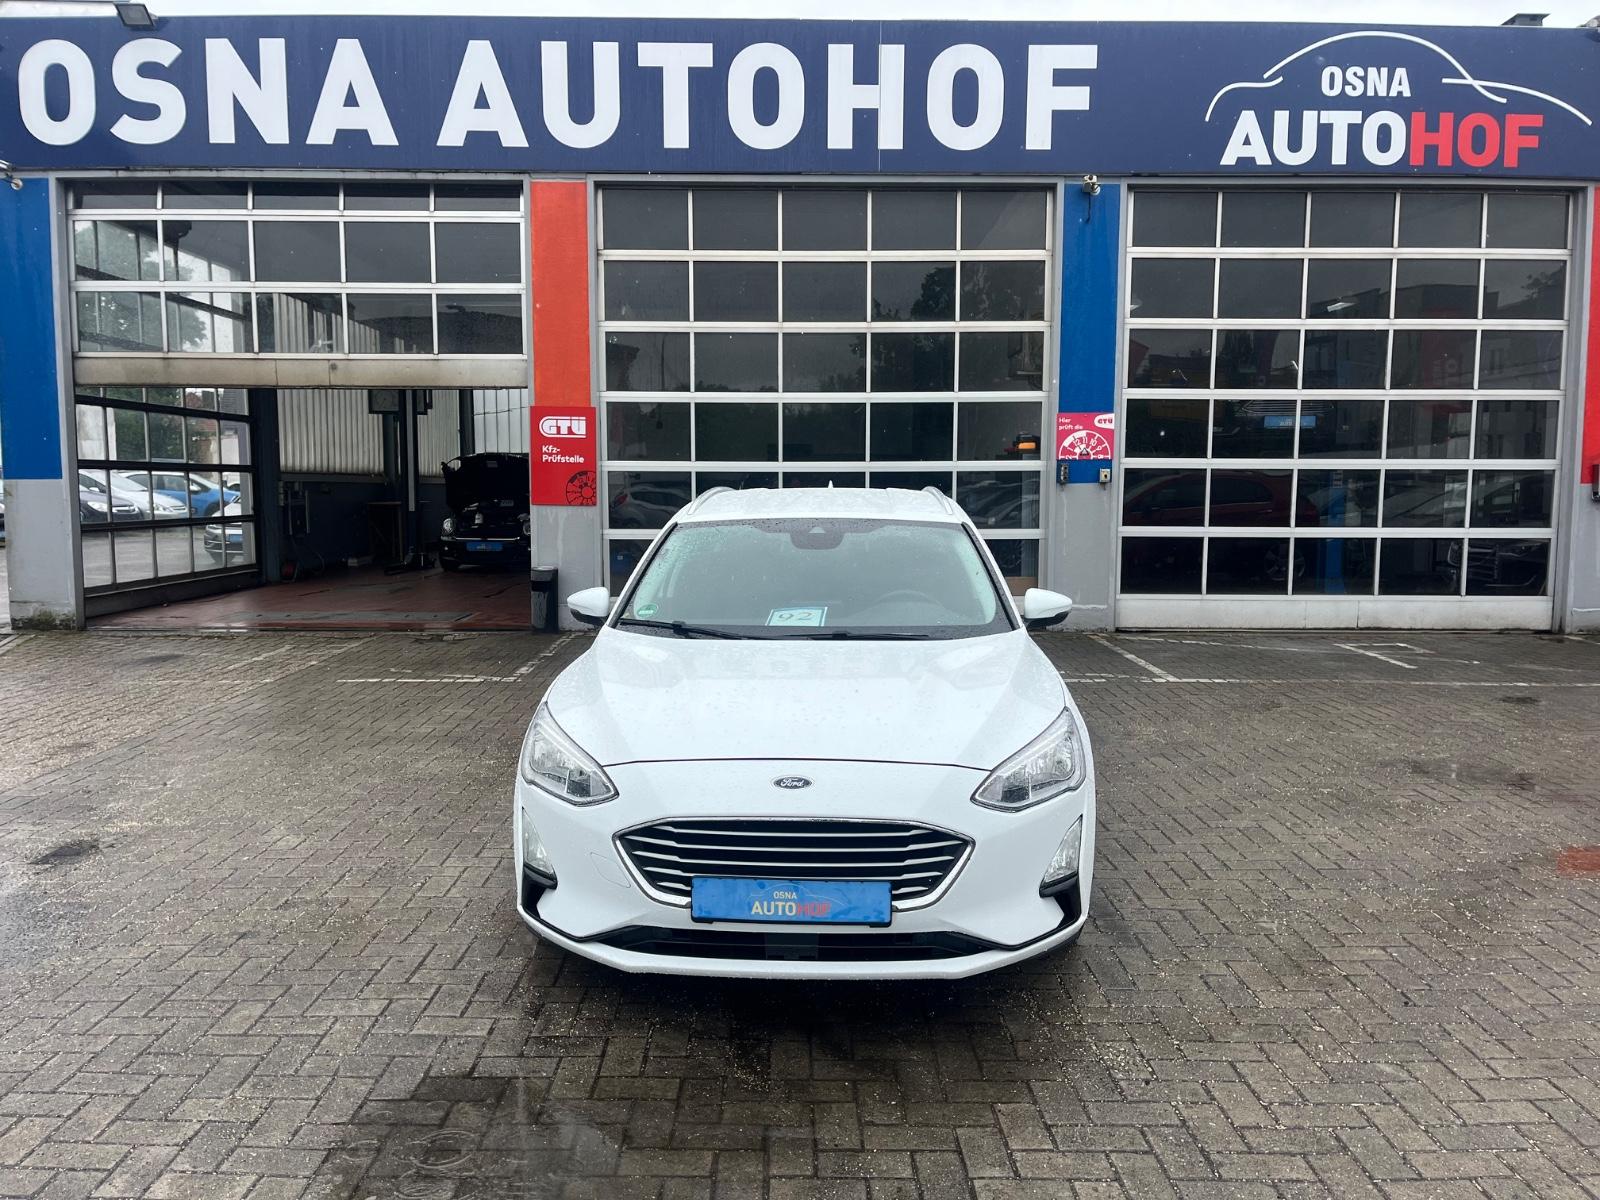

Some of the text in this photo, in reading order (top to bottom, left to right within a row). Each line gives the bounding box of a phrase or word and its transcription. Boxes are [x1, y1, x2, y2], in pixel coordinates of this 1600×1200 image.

[1321, 66, 1411, 98] OSNA
[18, 37, 1098, 151] OSNA AUTOHOF
[1220, 110, 1543, 168] AUTOHOF
[1089, 438, 1097, 446] 10
[542, 445, 561, 453] Kfz-
[542, 454, 584, 464] Prüfstelle
[780, 778, 805, 787] Ford
[773, 891, 798, 900] OSNA
[751, 901, 831, 917] AUTOHOF
